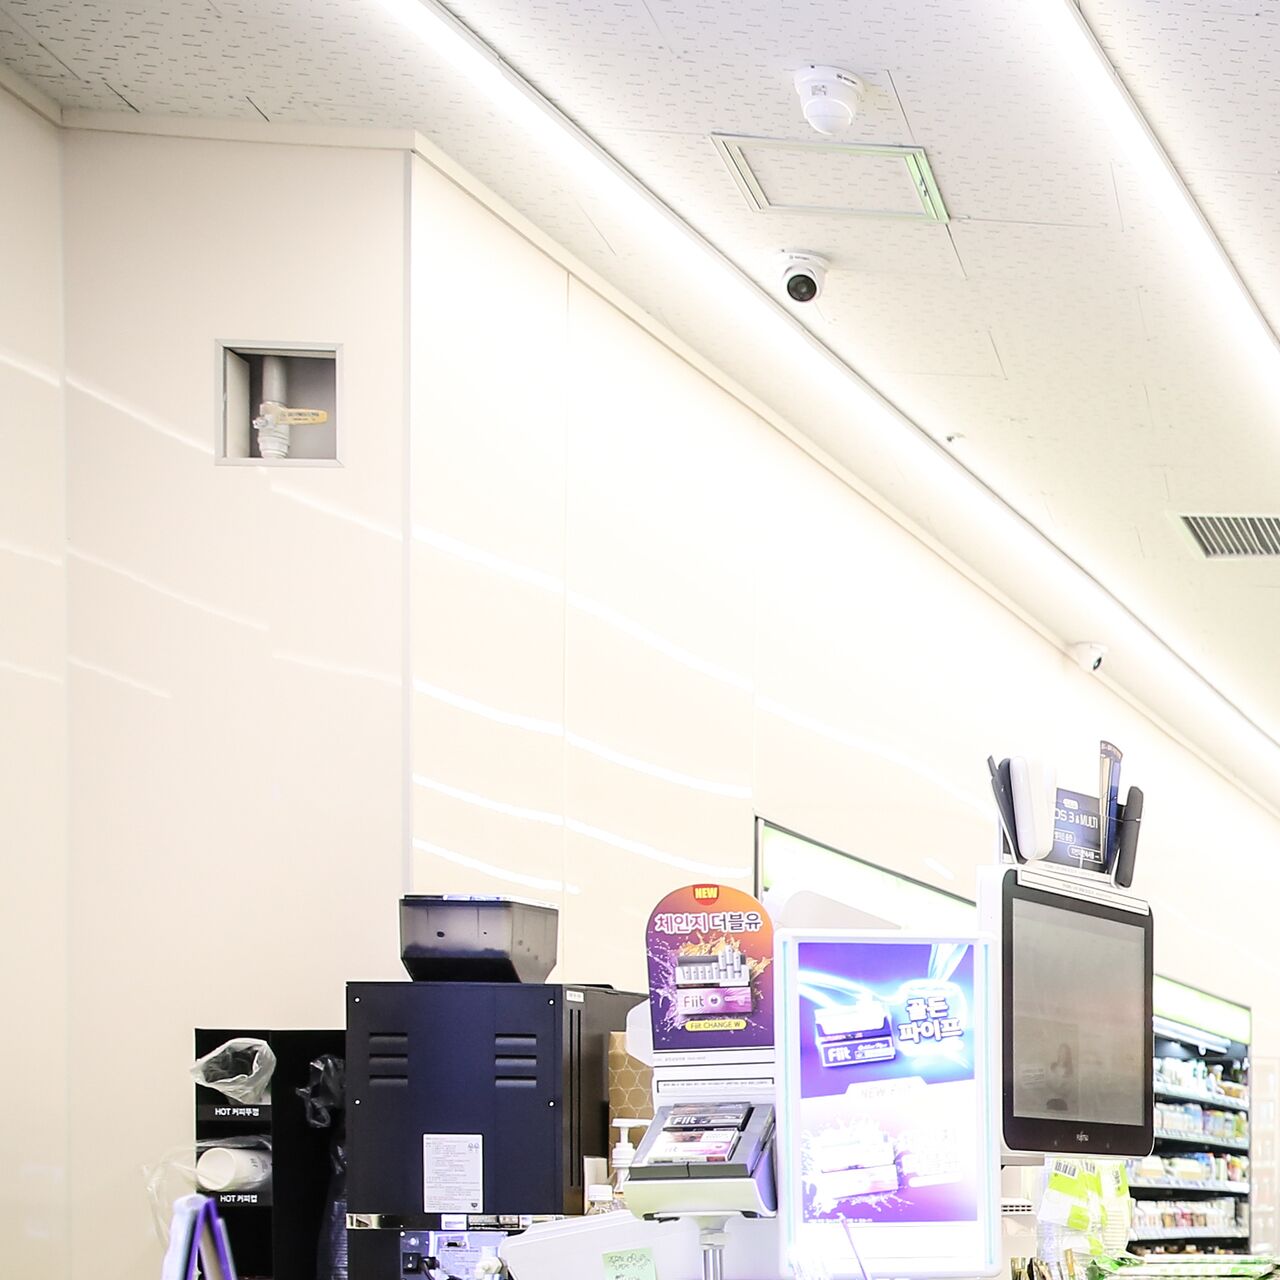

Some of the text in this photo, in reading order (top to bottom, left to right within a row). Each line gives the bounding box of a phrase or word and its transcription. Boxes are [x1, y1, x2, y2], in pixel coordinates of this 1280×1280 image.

[694, 887, 719, 899] NEW
[655, 912, 762, 933] 체인지 더블유
[684, 994, 704, 1007] Fiit
[703, 1021, 734, 1029] CHANGE
[897, 1016, 964, 1044] 파이프
[215, 1107, 230, 1116] HOT
[220, 1194, 235, 1203] HOT
